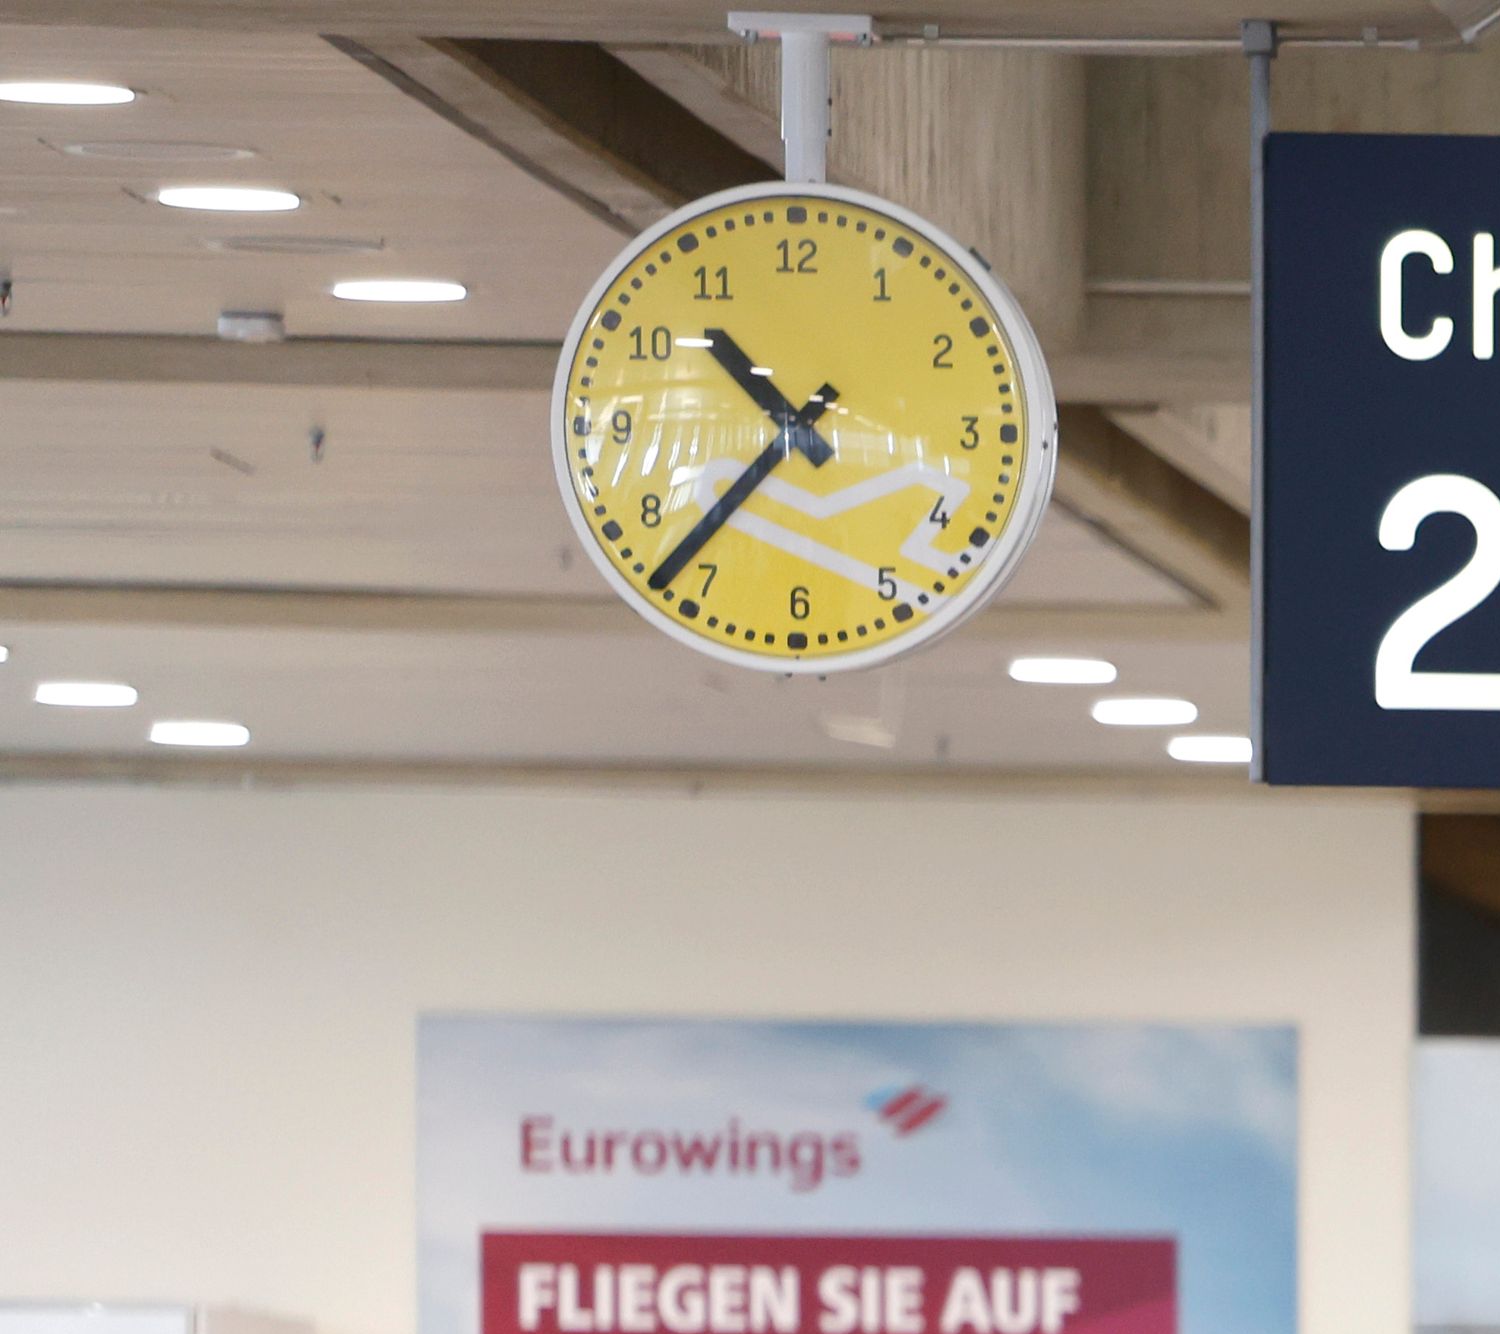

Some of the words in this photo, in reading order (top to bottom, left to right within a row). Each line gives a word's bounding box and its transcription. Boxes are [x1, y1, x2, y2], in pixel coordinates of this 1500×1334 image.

[775, 239, 818, 273] 12
[693, 266, 734, 300] 11
[873, 267, 891, 301] 1
[629, 328, 671, 361] 10
[932, 335, 953, 368] 2
[611, 410, 632, 445] 9
[960, 416, 980, 450] 3
[641, 494, 661, 527] 8
[928, 496, 950, 530] 4
[698, 565, 718, 598] 7
[877, 568, 898, 600] 5
[790, 586, 811, 620] 6
[519, 1116, 862, 1190] Eurowings
[516, 1264, 799, 1334] FLIEGEN
[819, 1267, 925, 1334] SIE
